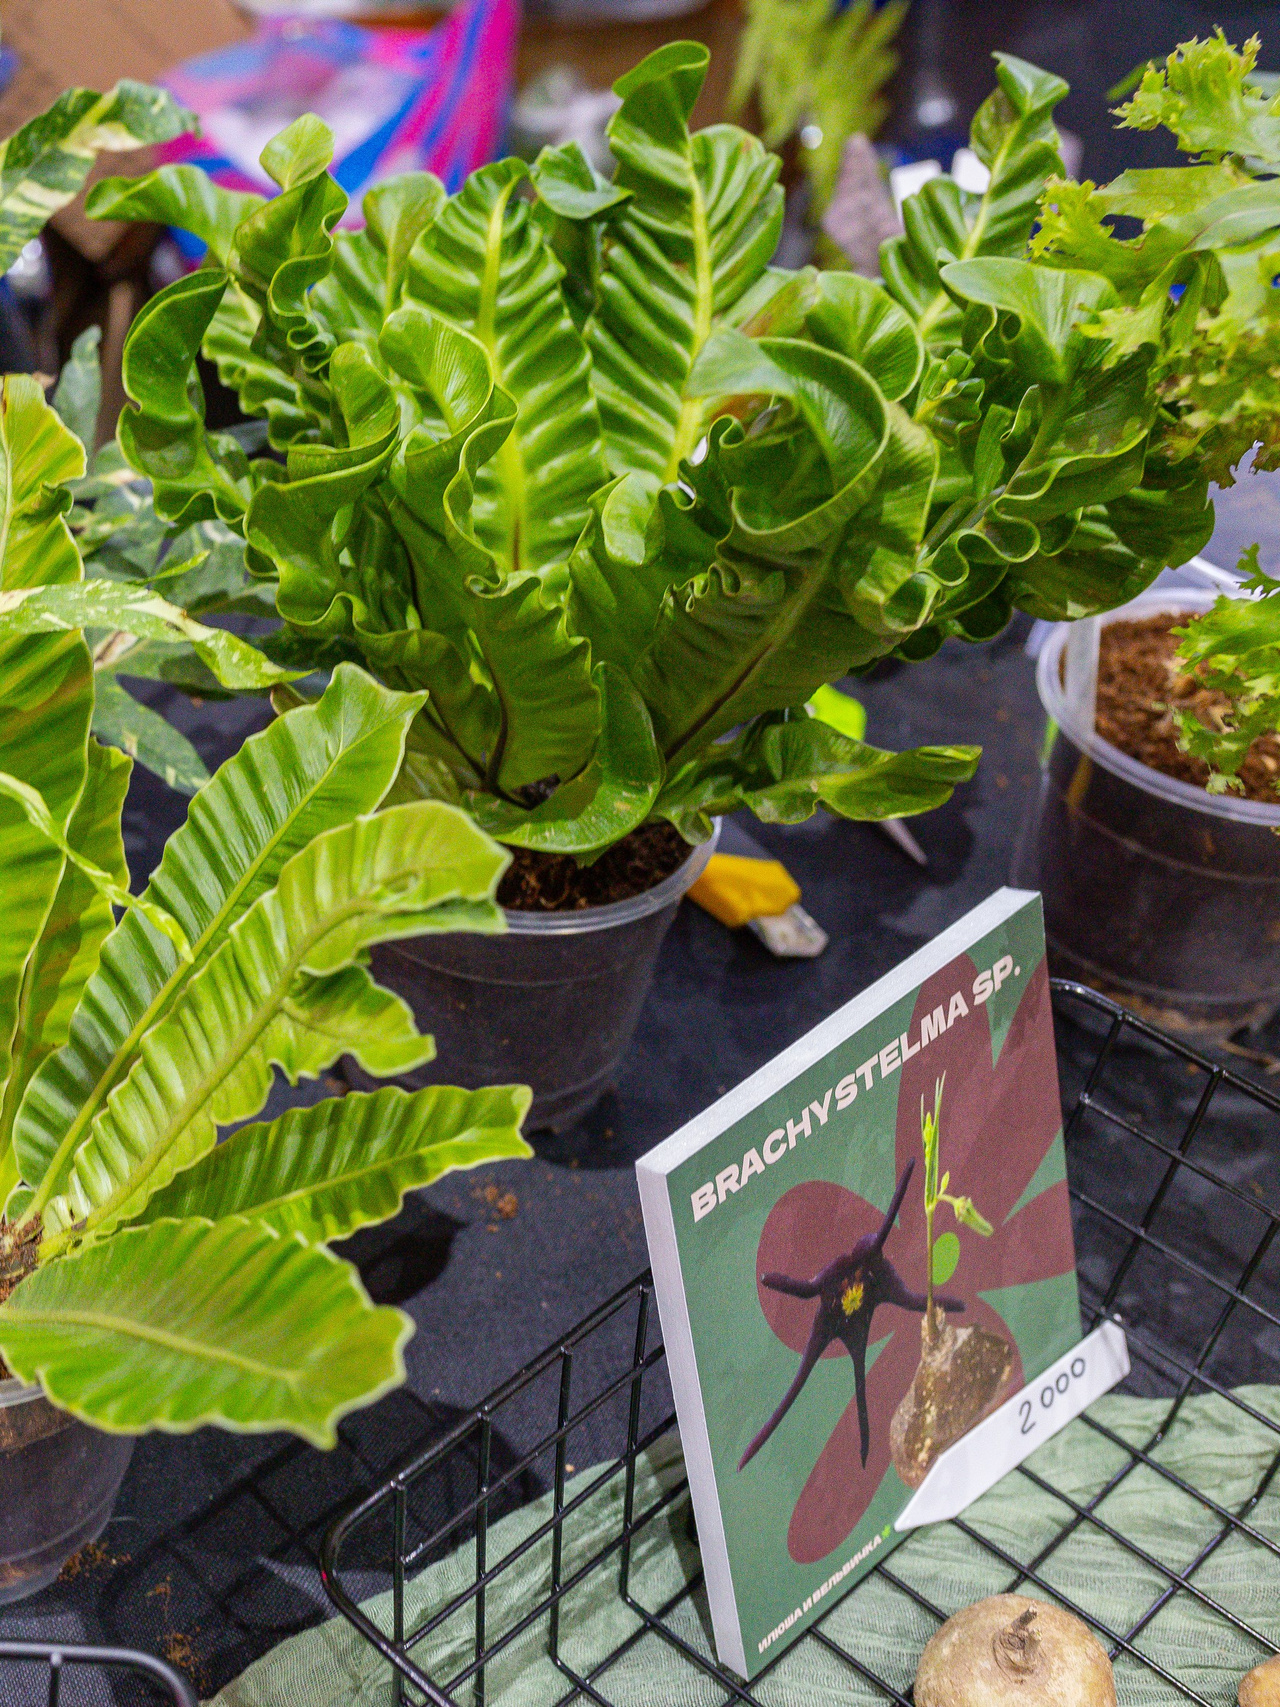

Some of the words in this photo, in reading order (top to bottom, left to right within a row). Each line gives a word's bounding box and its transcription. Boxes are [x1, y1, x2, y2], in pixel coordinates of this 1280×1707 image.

[690, 991, 969, 1223] BRACHYSTELMA
[972, 954, 1021, 1006] SP.
[758, 1607, 803, 1654] ИЛЮША
[802, 1596, 813, 1613] И
